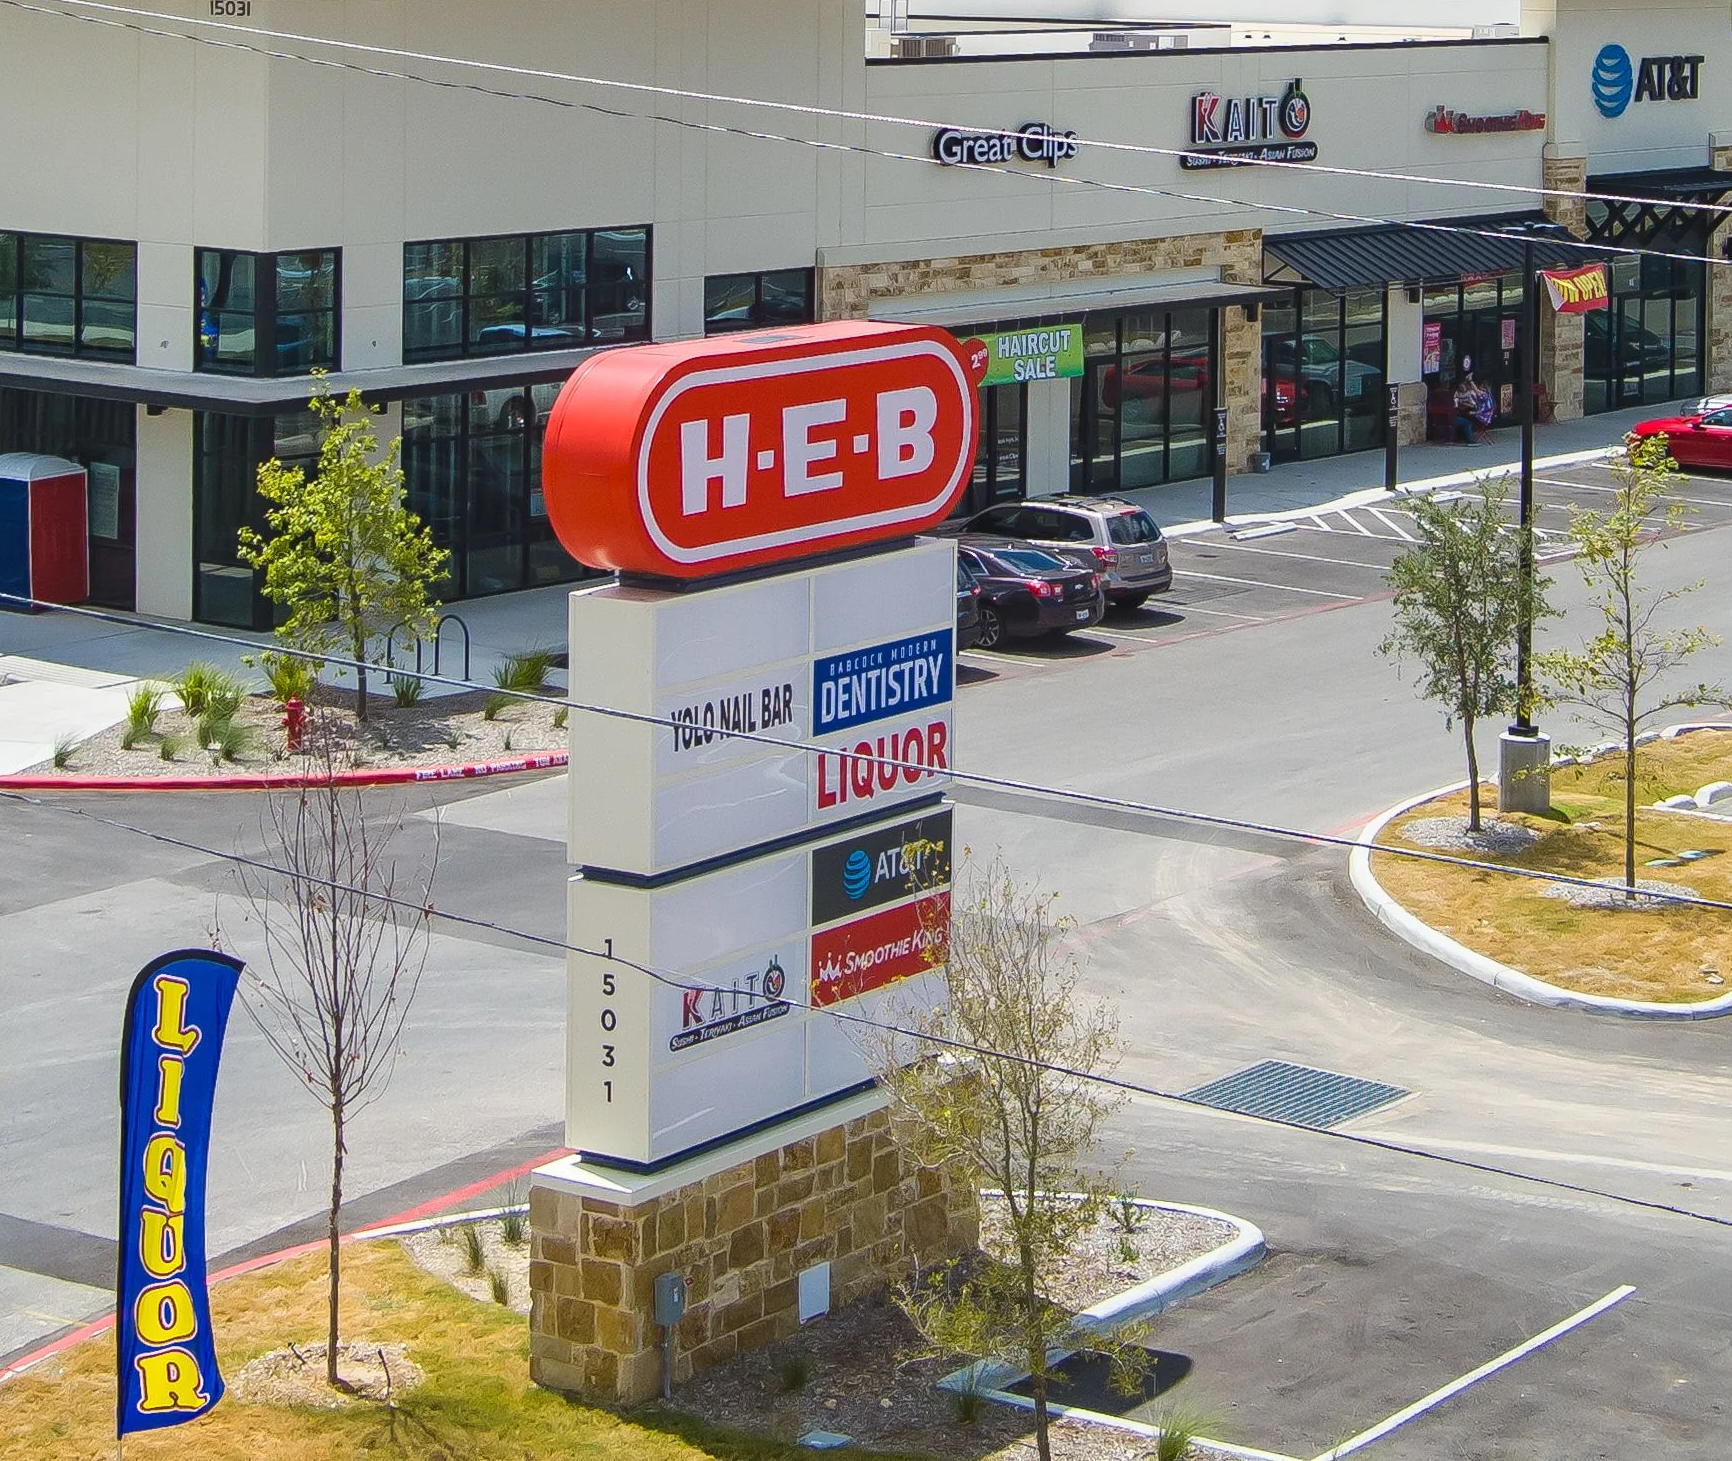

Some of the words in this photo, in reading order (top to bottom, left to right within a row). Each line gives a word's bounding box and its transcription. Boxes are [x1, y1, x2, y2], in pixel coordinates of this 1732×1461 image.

[210, 0, 251, 17] 15031
[1634, 55, 1706, 102] AT&T
[937, 129, 1013, 165] Great
[1021, 123, 1080, 167] Clips
[997, 329, 1072, 359] HAIRCUT
[1013, 355, 1057, 381] SALE
[829, 651, 884, 677] BABCOCK
[891, 638, 937, 662] MODERN
[820, 652, 944, 725] DENTISTRY
[670, 701, 715, 753] YOLO
[719, 692, 757, 741] NAIL
[761, 683, 793, 730] BAR
[817, 721, 948, 810] LIQUOR
[844, 936, 912, 975] SMOOTHIE
[134, 973, 211, 1414] LIQUOR
